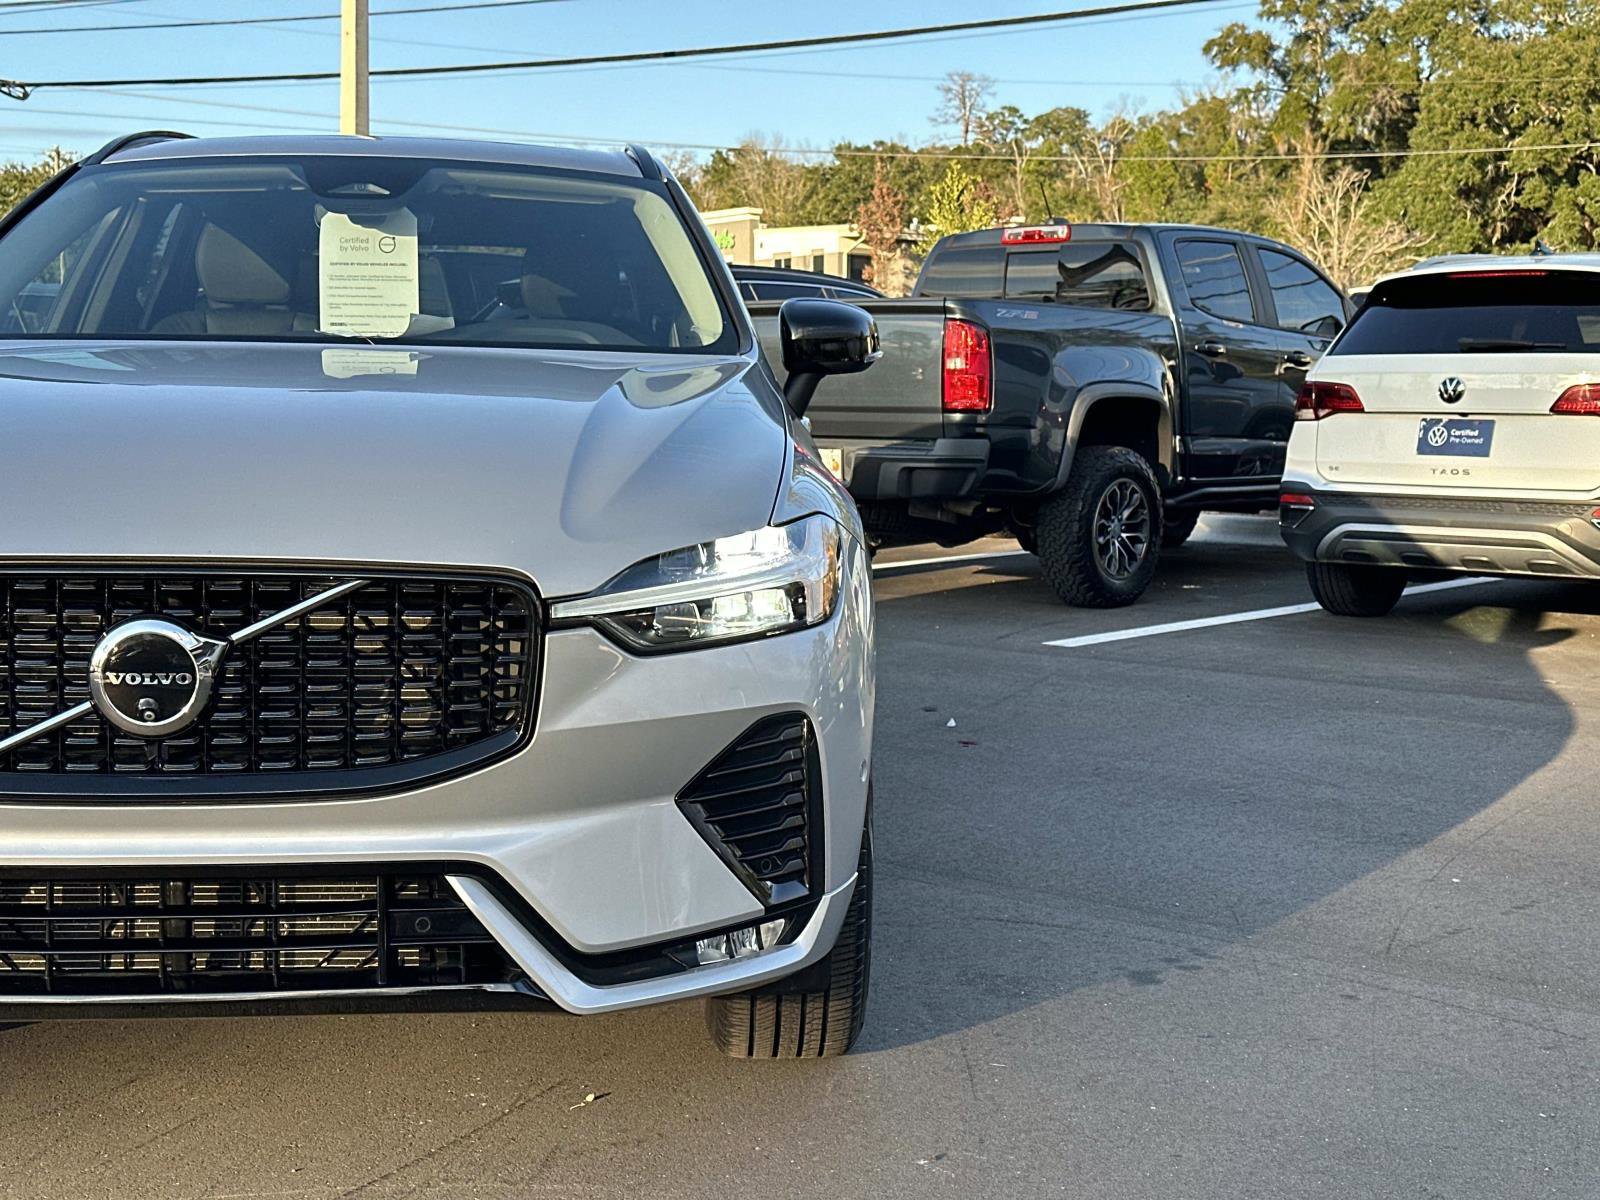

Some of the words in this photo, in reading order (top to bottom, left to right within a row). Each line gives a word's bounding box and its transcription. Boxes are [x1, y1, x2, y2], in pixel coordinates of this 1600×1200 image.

[340, 236, 369, 244] Certified
[340, 245, 348, 253] by
[1450, 429, 1479, 437] Certified
[1430, 468, 1471, 476] TAOS
[105, 672, 193, 685] VOLVO
